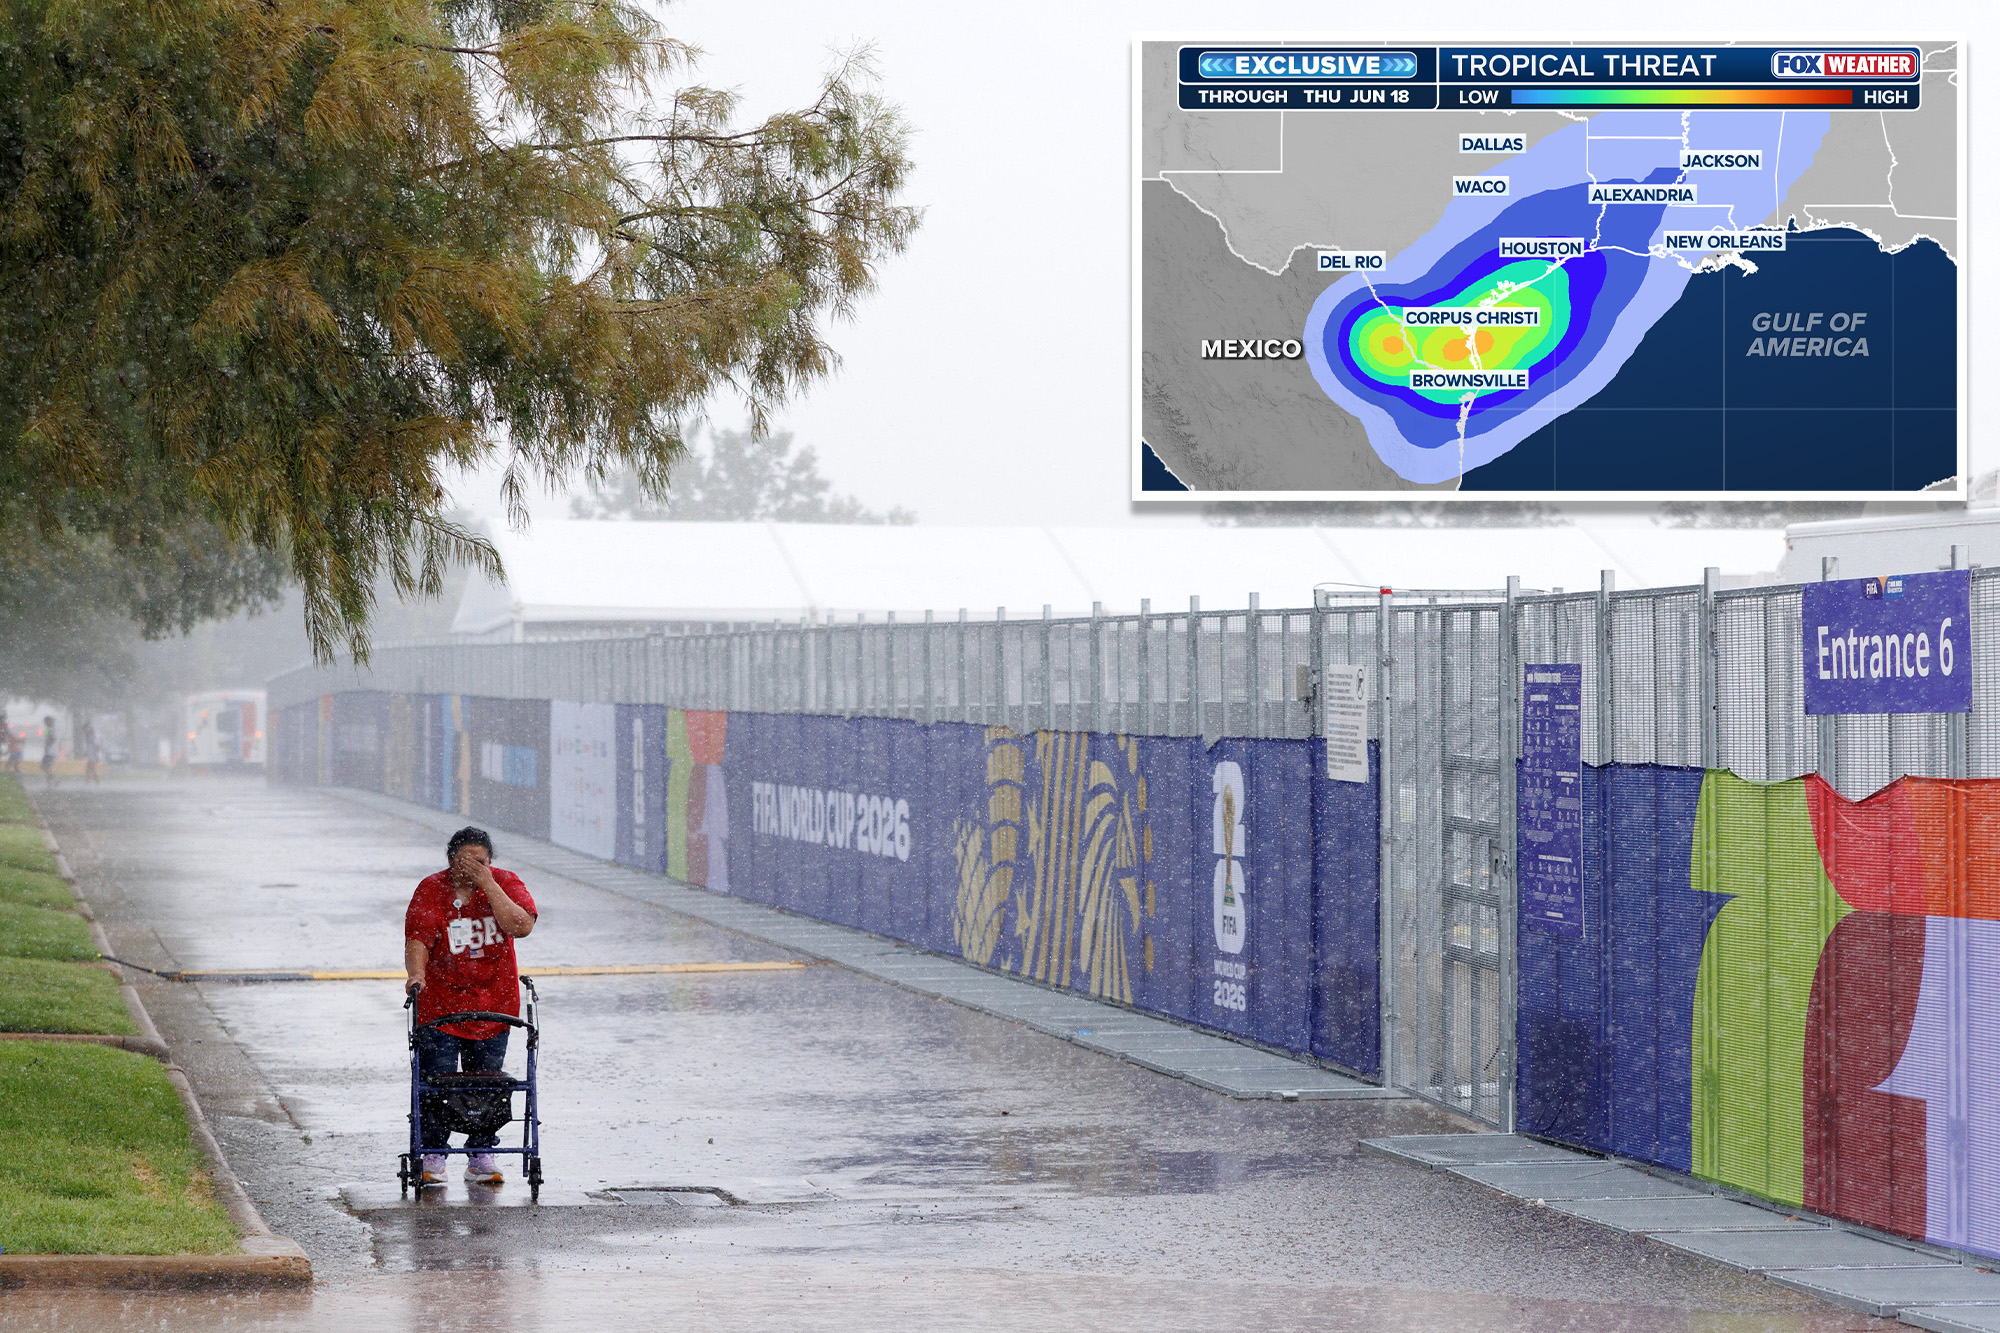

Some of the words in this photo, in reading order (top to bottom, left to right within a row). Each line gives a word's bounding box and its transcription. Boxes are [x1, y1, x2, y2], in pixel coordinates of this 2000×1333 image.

[1818, 626, 1930, 679] Entrance
[1939, 617, 1954, 676] 6
[752, 781, 779, 837] FIFA
[778, 784, 824, 844] WORLD
[826, 789, 855, 850] CUP
[857, 793, 910, 862] 2026
[1222, 914, 1237, 937] FIFA
[1213, 980, 1246, 1012] 2026
